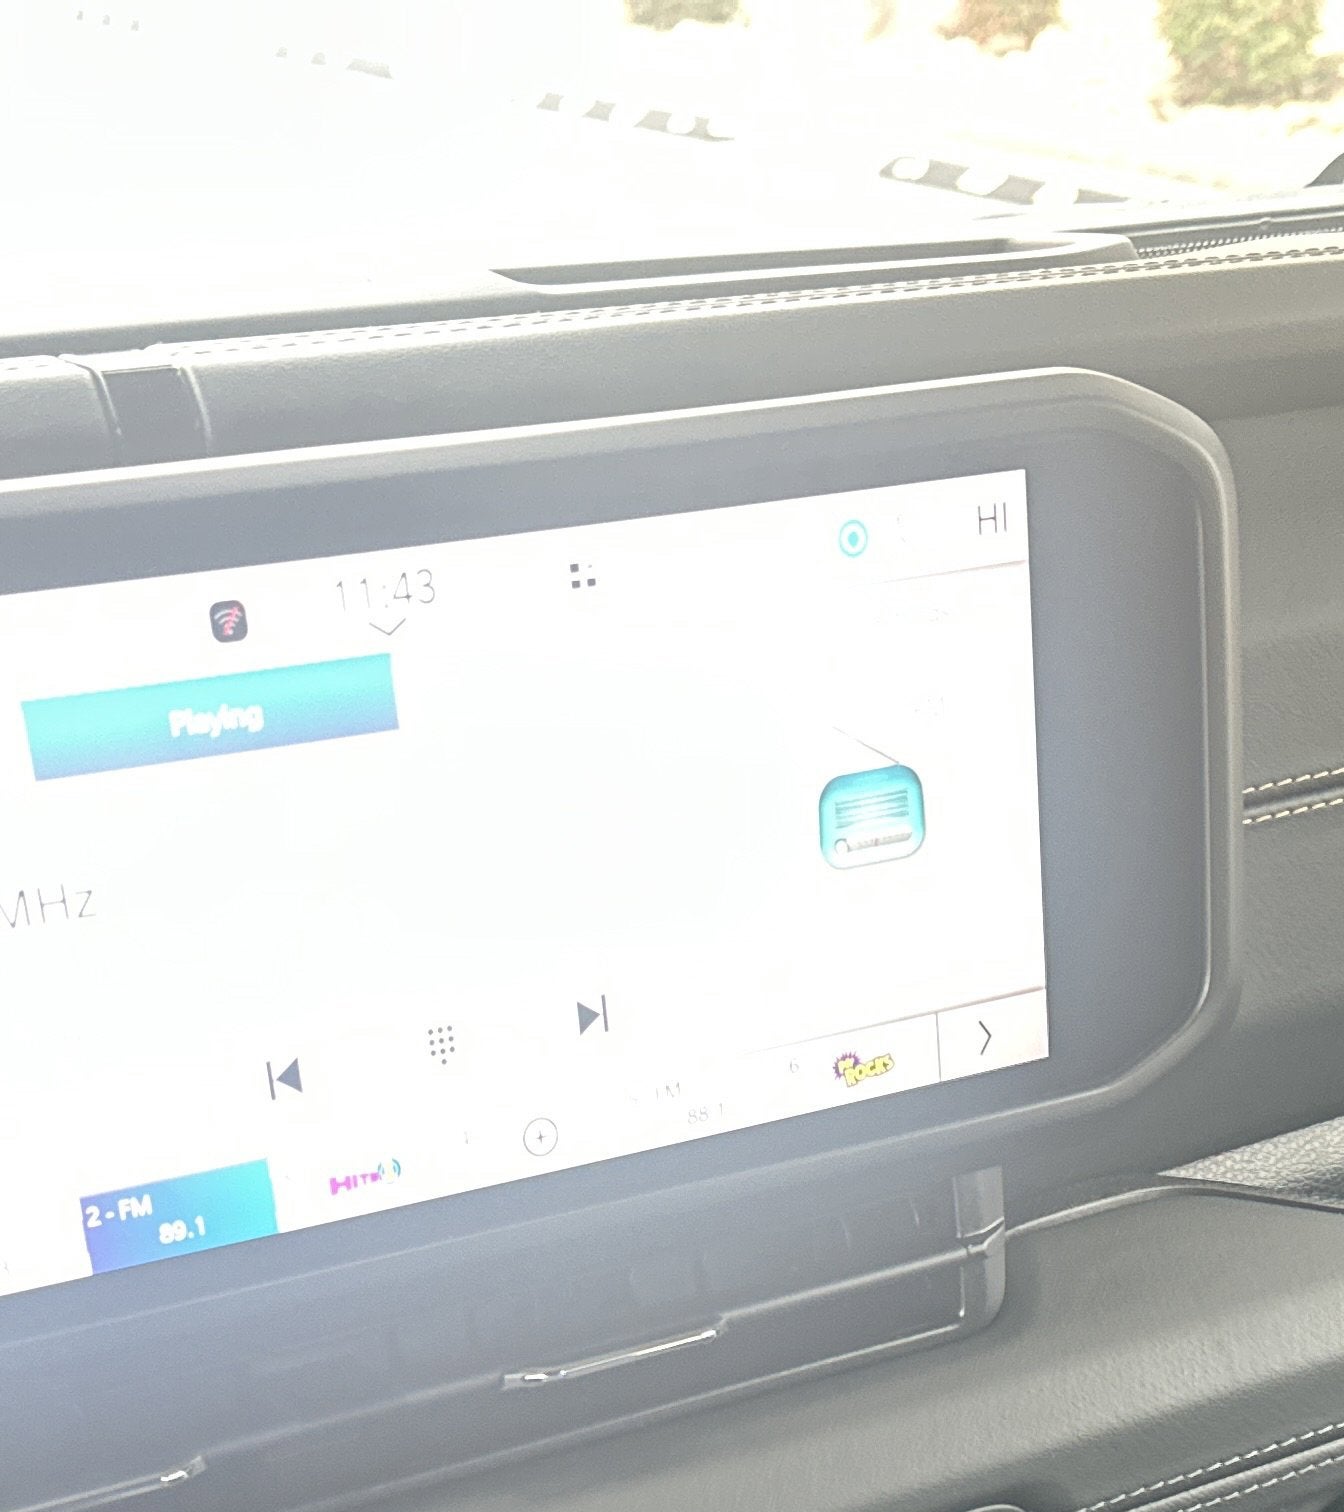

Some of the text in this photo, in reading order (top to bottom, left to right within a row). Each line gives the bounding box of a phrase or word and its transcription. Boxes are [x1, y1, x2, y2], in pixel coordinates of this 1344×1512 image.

[977, 502, 1007, 535] HI
[335, 569, 437, 612] 11:43
[168, 704, 265, 739] Playing
[85, 1205, 102, 1228] 2
[118, 1194, 153, 1222] FM
[159, 1215, 206, 1245] 89.1
